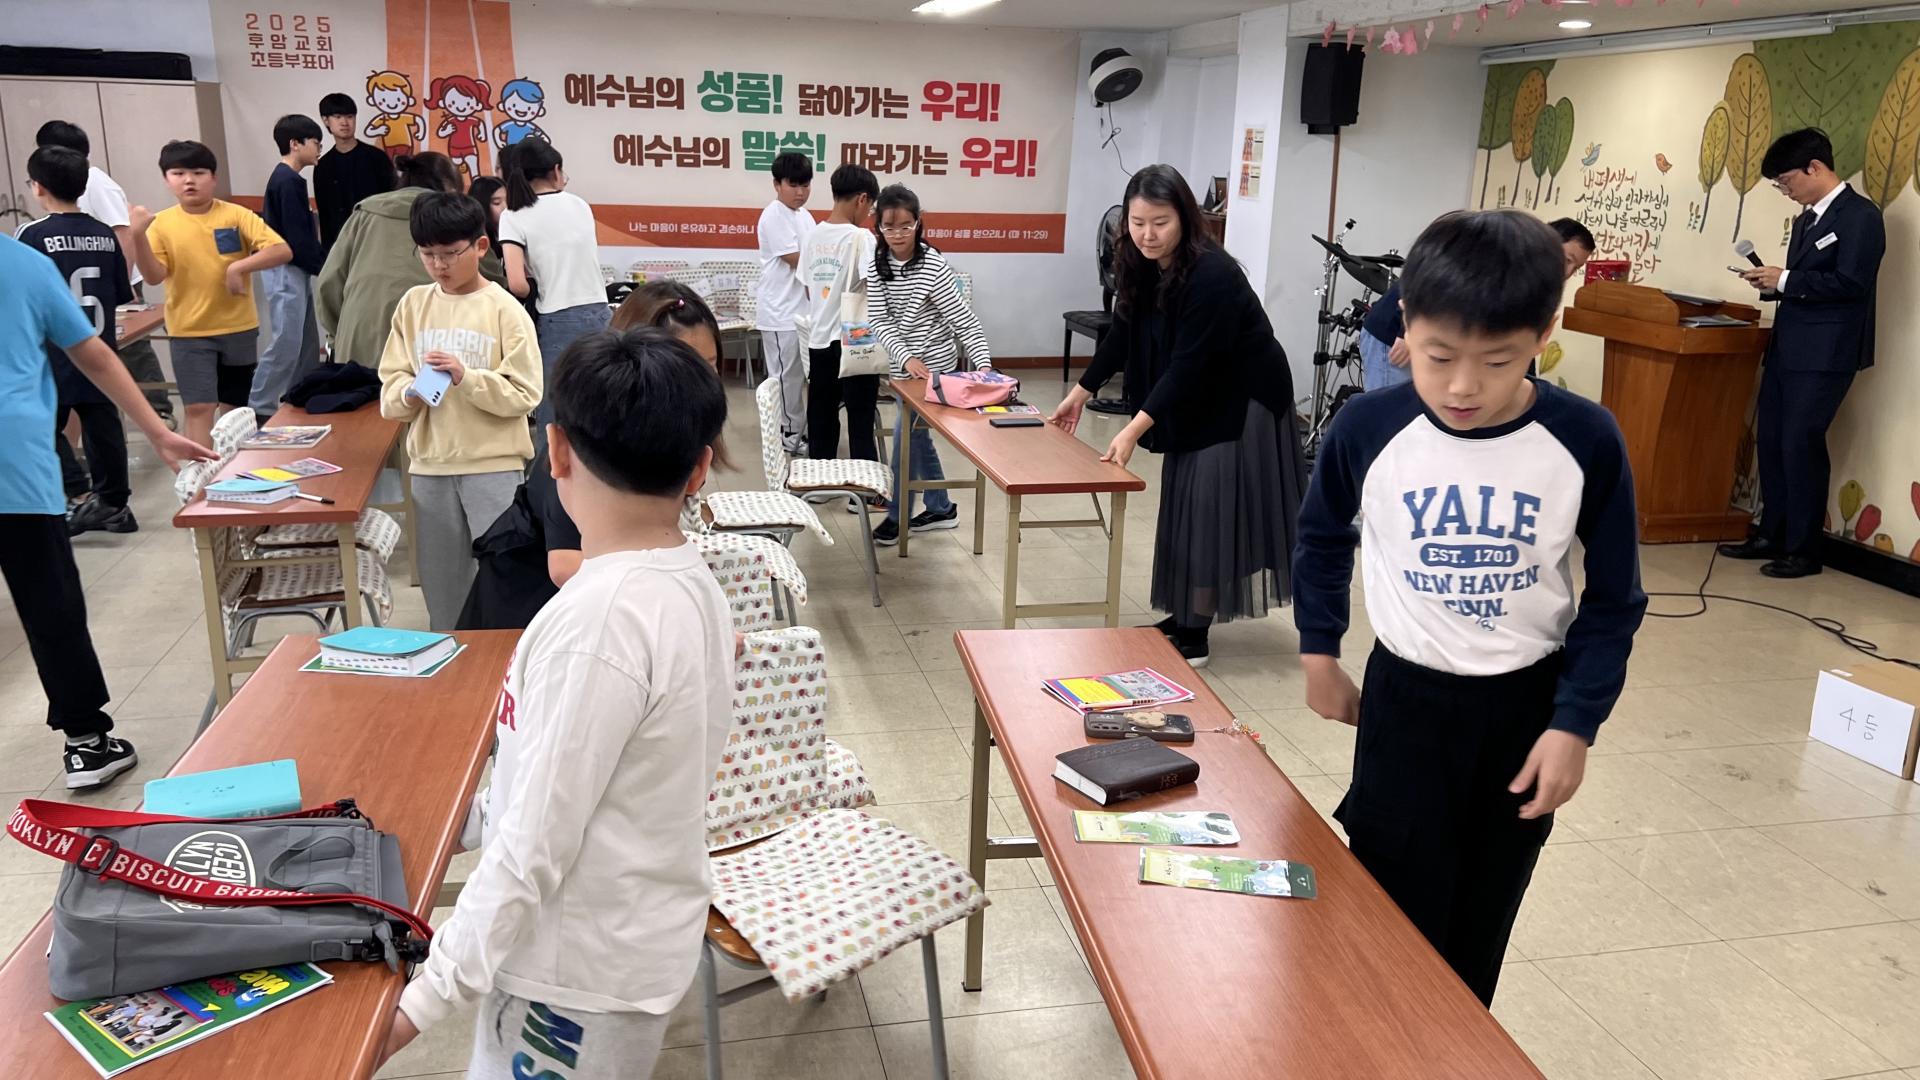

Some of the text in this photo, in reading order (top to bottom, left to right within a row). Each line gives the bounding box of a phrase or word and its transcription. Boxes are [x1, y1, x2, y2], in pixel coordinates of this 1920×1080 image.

[245, 13, 331, 33] 2025
[248, 33, 332, 51] 후암교회
[250, 51, 334, 70] 초등부표어
[564, 70, 1001, 122] 예수님의 성품! 닮아가는 우리!
[613, 134, 731, 168] 예수님의
[841, 143, 949, 176] 따라가는
[960, 137, 1038, 177] 우리!
[629, 222, 755, 234] 나는 마음이 온유하고 겸손하니
[927, 229, 952, 239] 마음이
[1023, 230, 1049, 240] 11:29)
[44, 236, 116, 253] BELLINGHAM
[1403, 484, 1541, 546] YALE
[1428, 548, 1513, 563] EST. 1701
[1403, 565, 1540, 595] NEW HAVEN
